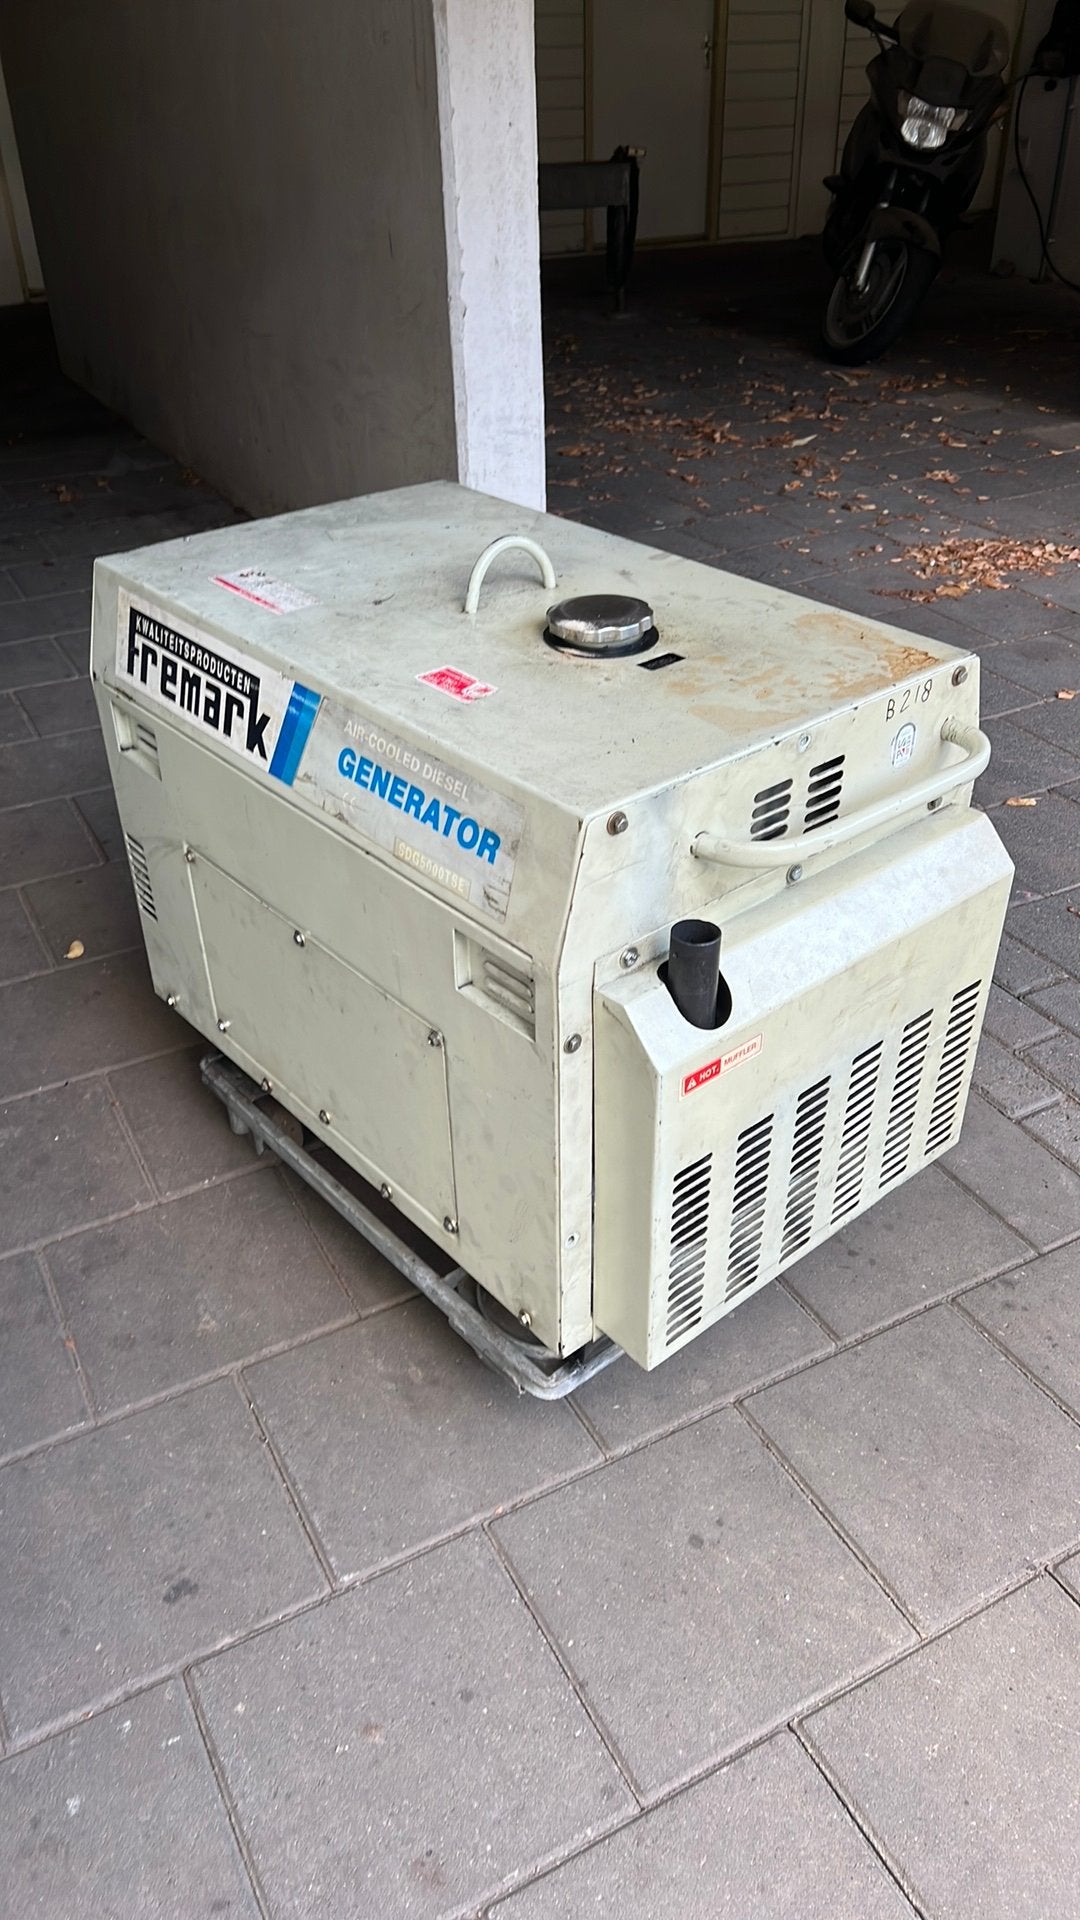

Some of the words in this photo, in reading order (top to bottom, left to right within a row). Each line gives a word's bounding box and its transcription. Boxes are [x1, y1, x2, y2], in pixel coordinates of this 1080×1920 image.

[135, 614, 252, 696] KWALITEITSPRODUCTEN
[343, 719, 420, 773] AIR-COOLED
[421, 762, 470, 802] DIESEL
[337, 746, 502, 866] GENERATOR
[723, 1041, 758, 1067] MUFFLER
